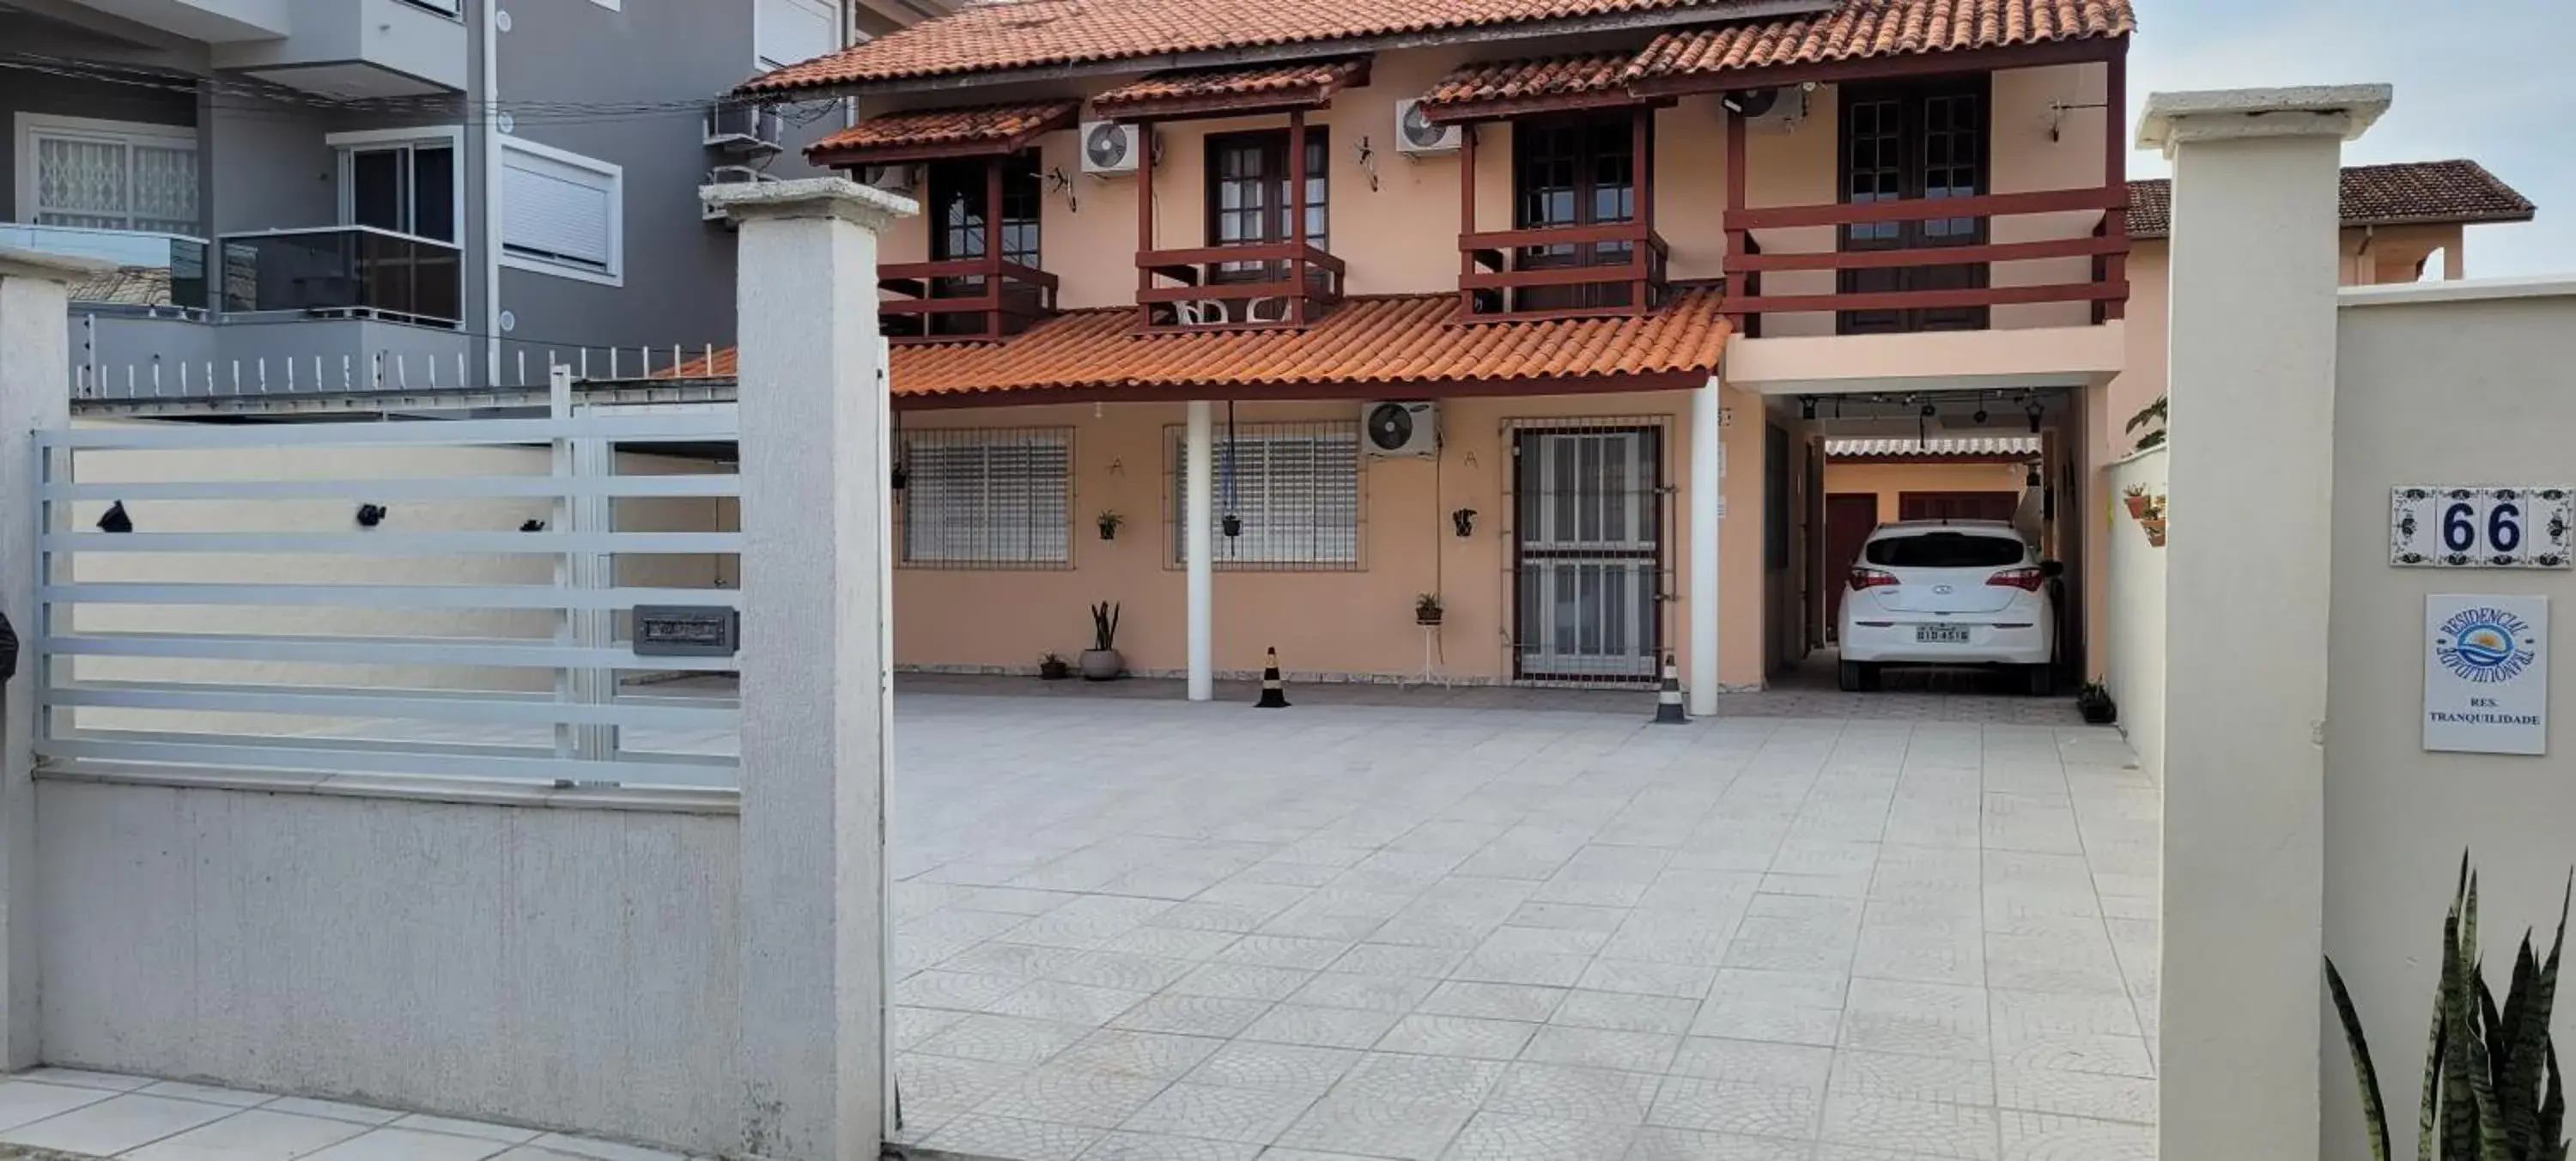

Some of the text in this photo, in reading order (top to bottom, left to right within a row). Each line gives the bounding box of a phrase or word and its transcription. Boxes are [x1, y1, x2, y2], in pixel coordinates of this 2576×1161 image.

[2443, 503, 2521, 552] 66
[2439, 606, 2529, 636] RESIDENCIAL
[2429, 712, 2541, 726] TRANQUILIDADE
